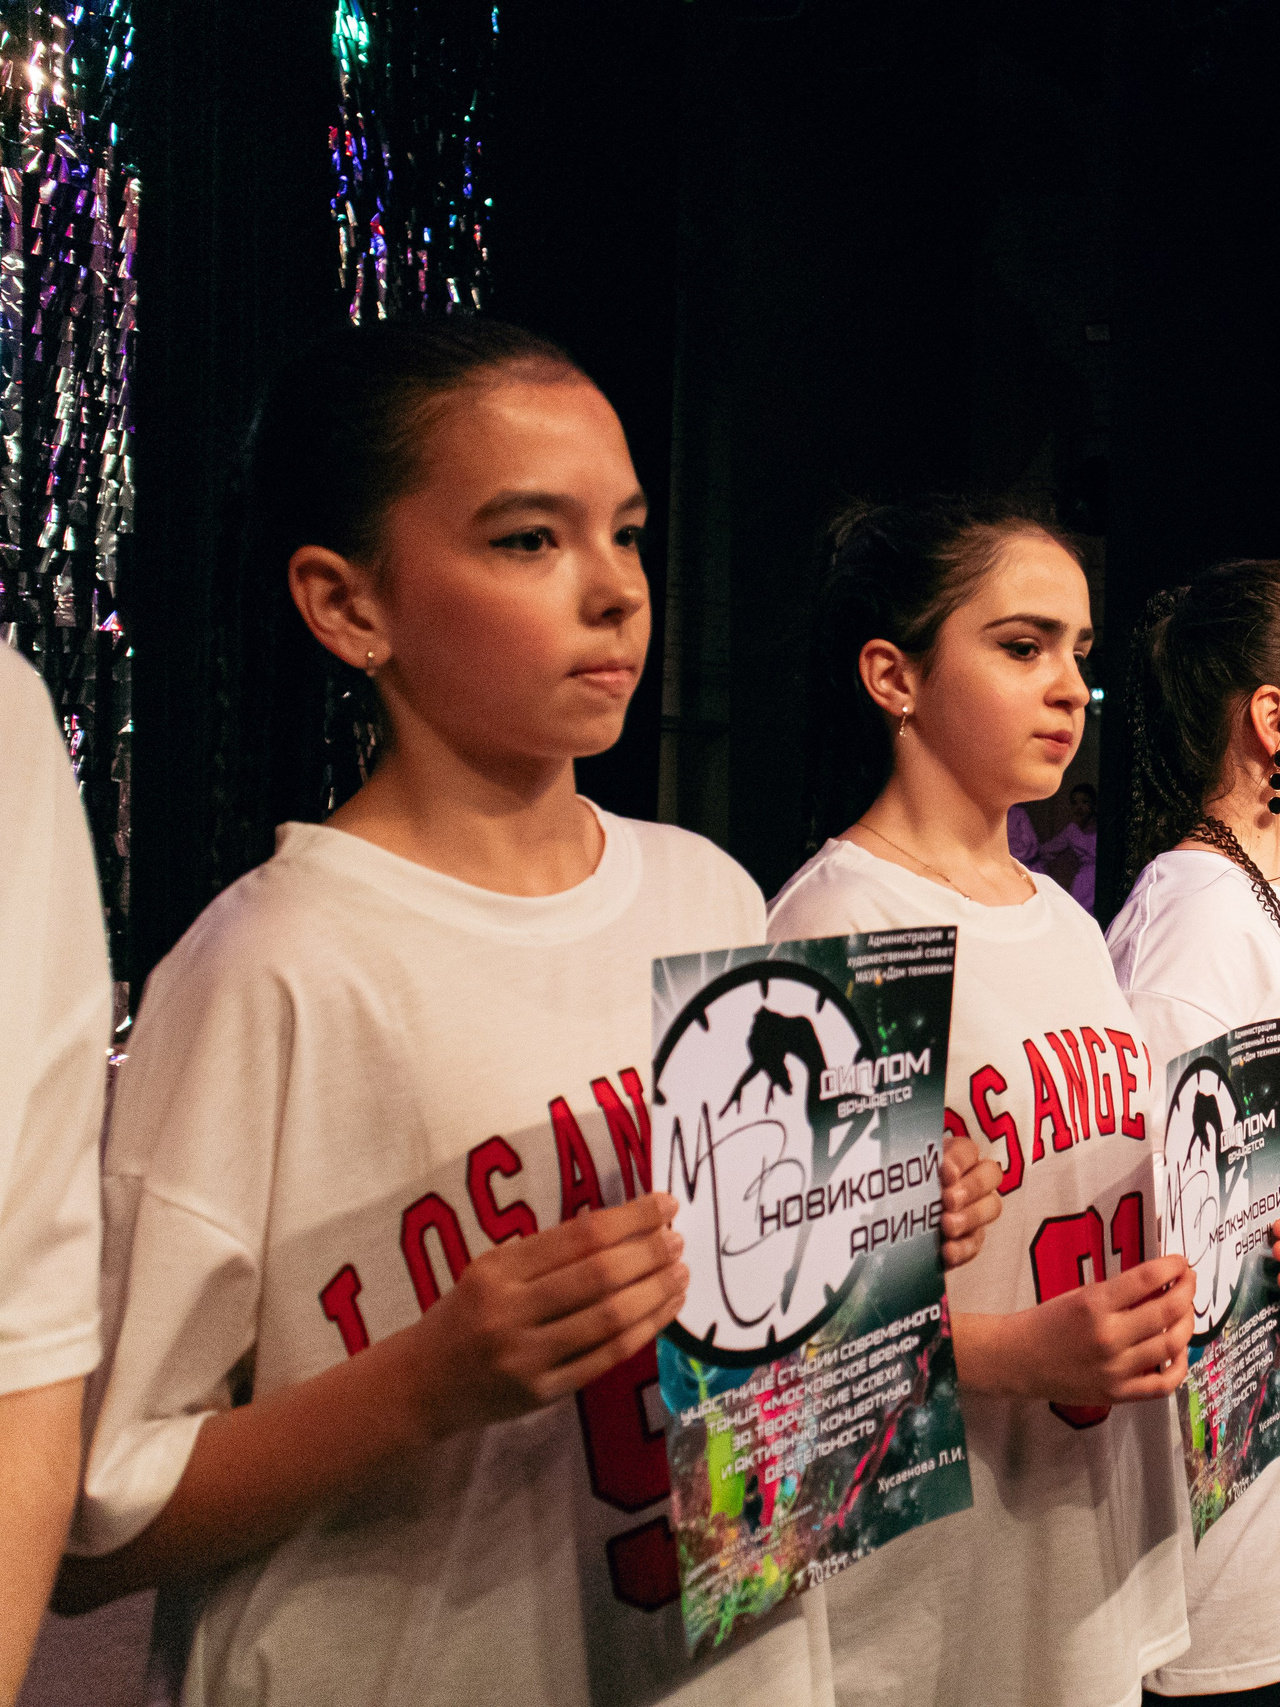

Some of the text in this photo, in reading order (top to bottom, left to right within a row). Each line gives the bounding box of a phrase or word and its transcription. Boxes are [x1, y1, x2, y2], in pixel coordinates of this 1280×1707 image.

[868, 930, 956, 947] Администрация и
[925, 946, 955, 959] совет
[819, 1047, 931, 1100] ДИПЛОМ
[837, 1085, 913, 1119] ВРУЧАЕТСЯ
[1022, 1026, 1152, 1165] ANGE
[1220, 1109, 1276, 1153] ДИПЛОМ
[759, 1143, 940, 1237] НОВИКОВОЙ
[850, 1199, 943, 1259] АРИНЕ
[1235, 1222, 1273, 1260] РУЗАН
[681, 1304, 942, 1427] УЧАСТНИЦЕ СТУДИИ СОВРЕМЕННОГО
[708, 1400, 760, 1436] ТАНЦА
[868, 1335, 921, 1369] ВРЕМЯ»
[731, 1363, 904, 1452] ЗА ТВОРЧЕСКИЕ УСПЕХИ
[820, 1379, 912, 1433] КОНЦЕРТНУЮ
[764, 1418, 877, 1485] ДЕЯТЕЛЬНОСТЬ
